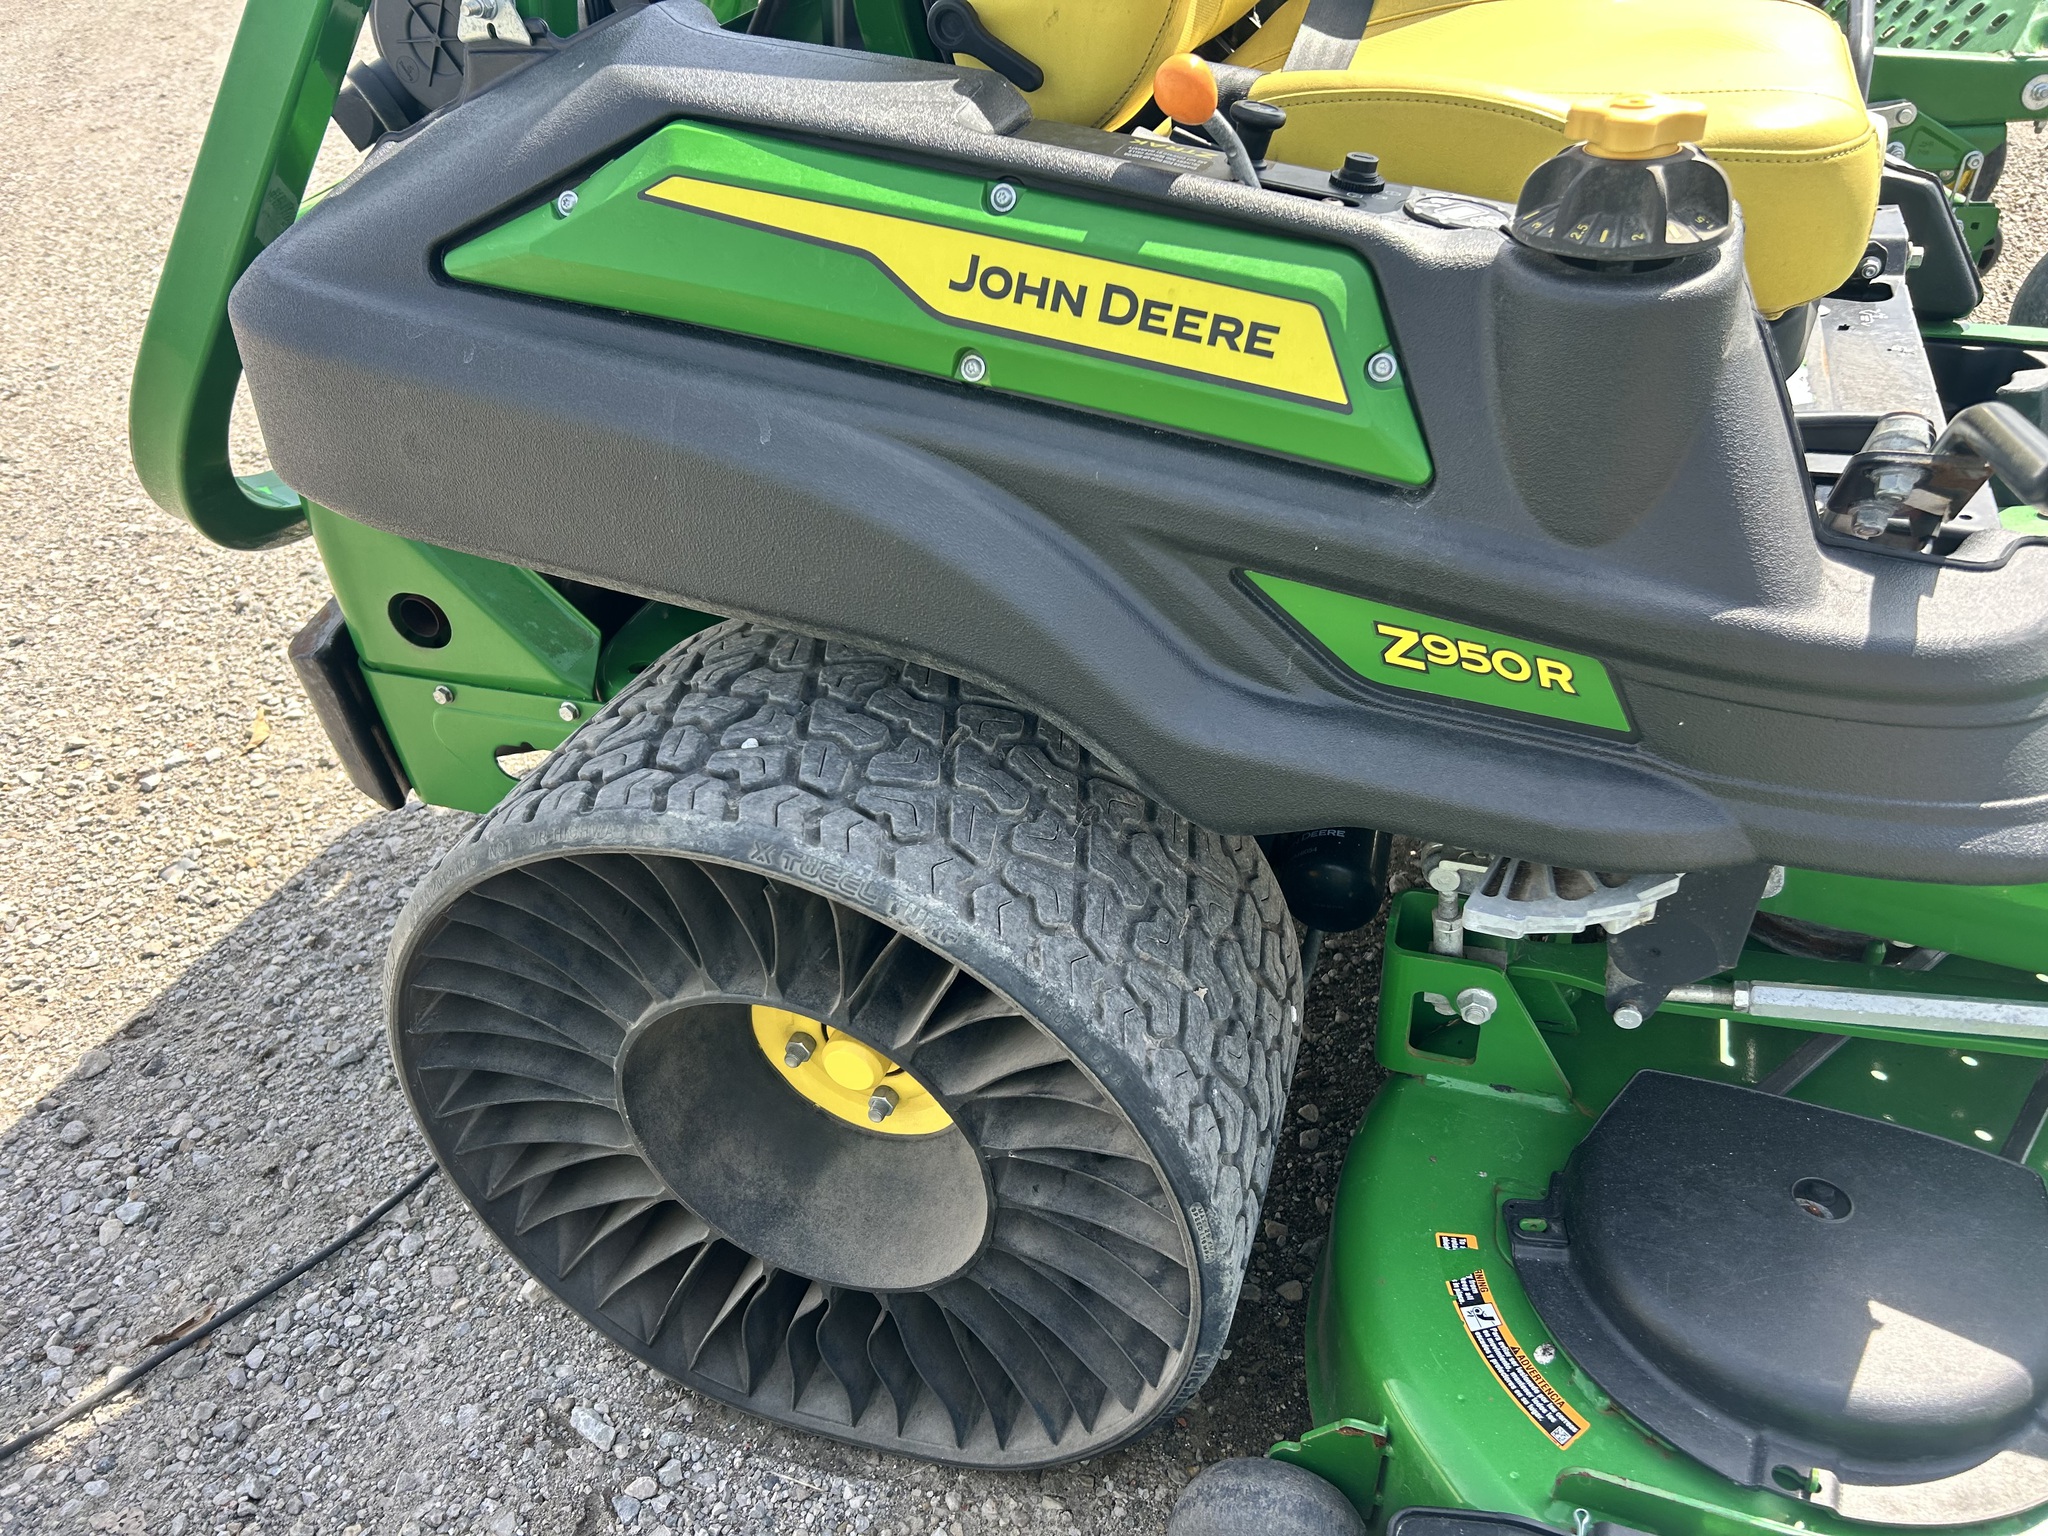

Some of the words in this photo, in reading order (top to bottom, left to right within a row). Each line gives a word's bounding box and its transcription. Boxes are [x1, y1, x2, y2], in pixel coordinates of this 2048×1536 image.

[1569, 223, 1590, 241] 2.5
[1631, 232, 1646, 242] 2
[948, 254, 1088, 318] JOHN
[1098, 283, 1281, 359] DEERE
[780, 850, 878, 904] TWEEL
[1033, 994, 1076, 1033] MADE
[1517, 1354, 1566, 1408] ADVERTENCIA
[1535, 1393, 1550, 1404] por
